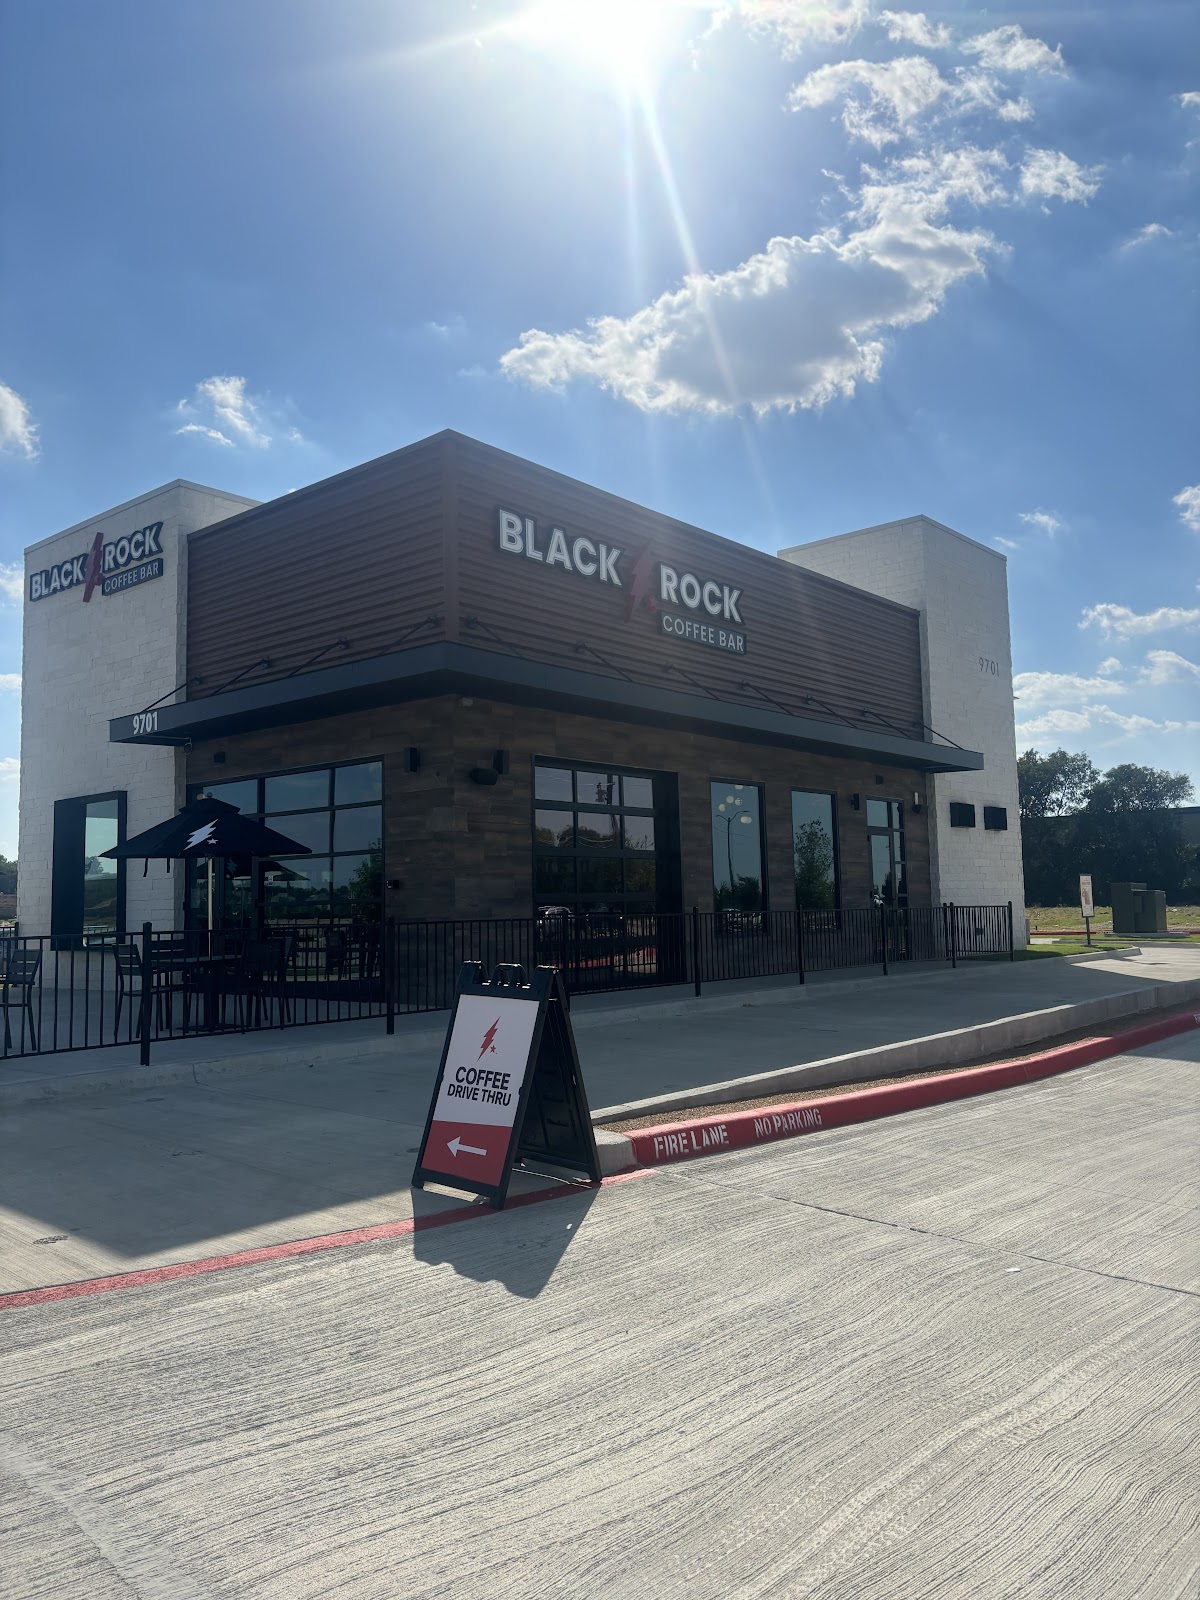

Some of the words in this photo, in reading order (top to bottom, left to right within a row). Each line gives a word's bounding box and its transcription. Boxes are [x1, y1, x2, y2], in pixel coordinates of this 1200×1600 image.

[31, 556, 84, 599] BLACK
[104, 525, 158, 570] ROCK
[104, 570, 138, 593] COFFEE
[140, 561, 159, 580] BAR
[499, 509, 622, 586] BLACK
[660, 564, 741, 623] ROCK
[662, 615, 715, 644] COFFEE
[719, 631, 744, 652] BAR
[978, 657, 999, 678] 9701
[132, 711, 158, 735] 9701
[455, 1066, 511, 1090] COFFEE
[447, 1083, 479, 1100] DRIVE
[481, 1089, 512, 1106] THRU
[753, 1117, 772, 1138] NO
[772, 1108, 823, 1136] PARKING
[653, 1133, 689, 1159] FIRE
[690, 1124, 729, 1149] LANE
